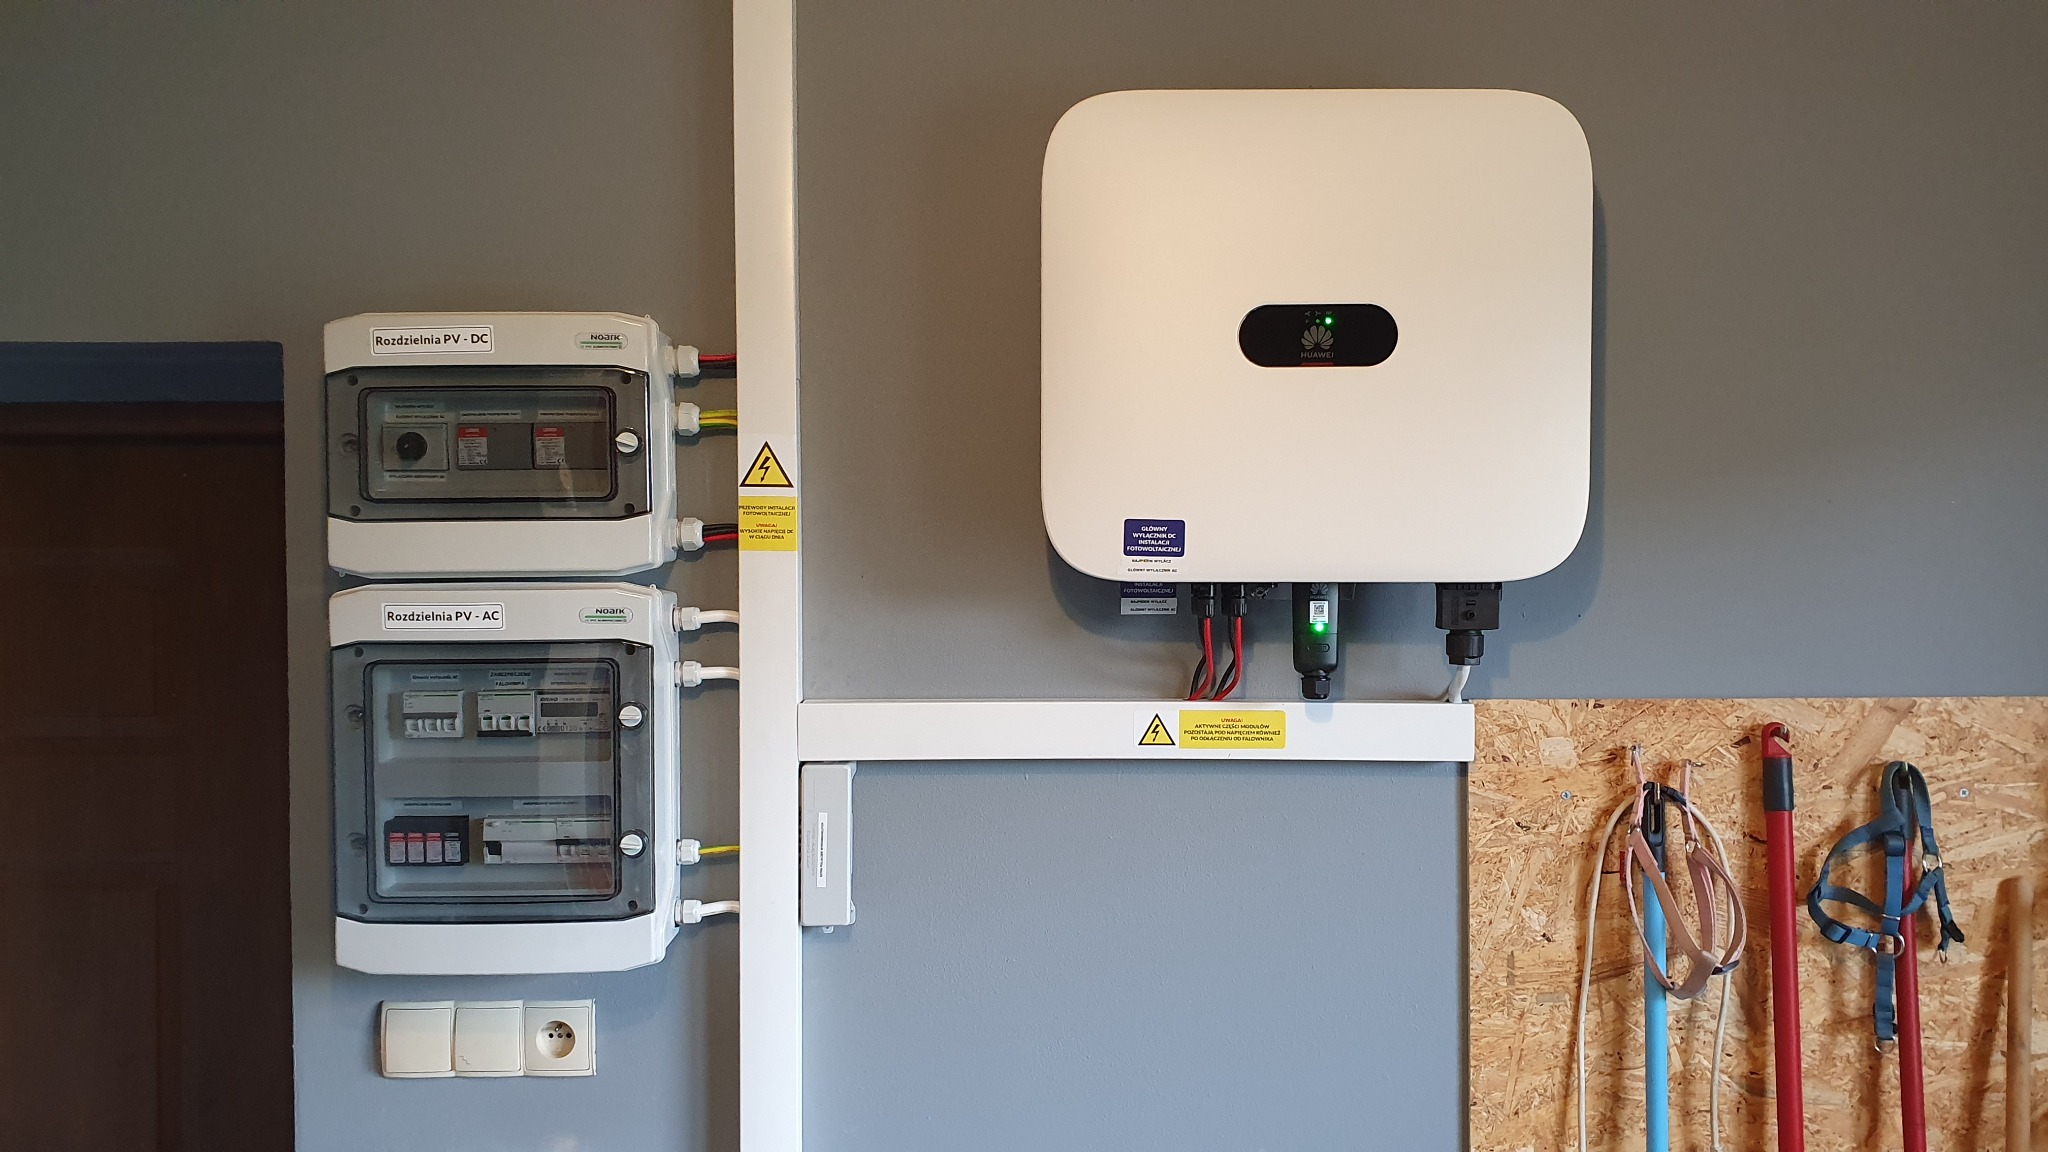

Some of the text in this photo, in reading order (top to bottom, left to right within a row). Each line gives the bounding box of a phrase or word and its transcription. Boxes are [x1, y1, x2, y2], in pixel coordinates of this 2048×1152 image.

[375, 335, 441, 346] Rozdzielnia
[443, 334, 461, 344] PV
[470, 333, 489, 344] DC
[387, 611, 453, 622] Rozdzielnia
[455, 611, 472, 622] PV
[482, 611, 500, 621] AC
